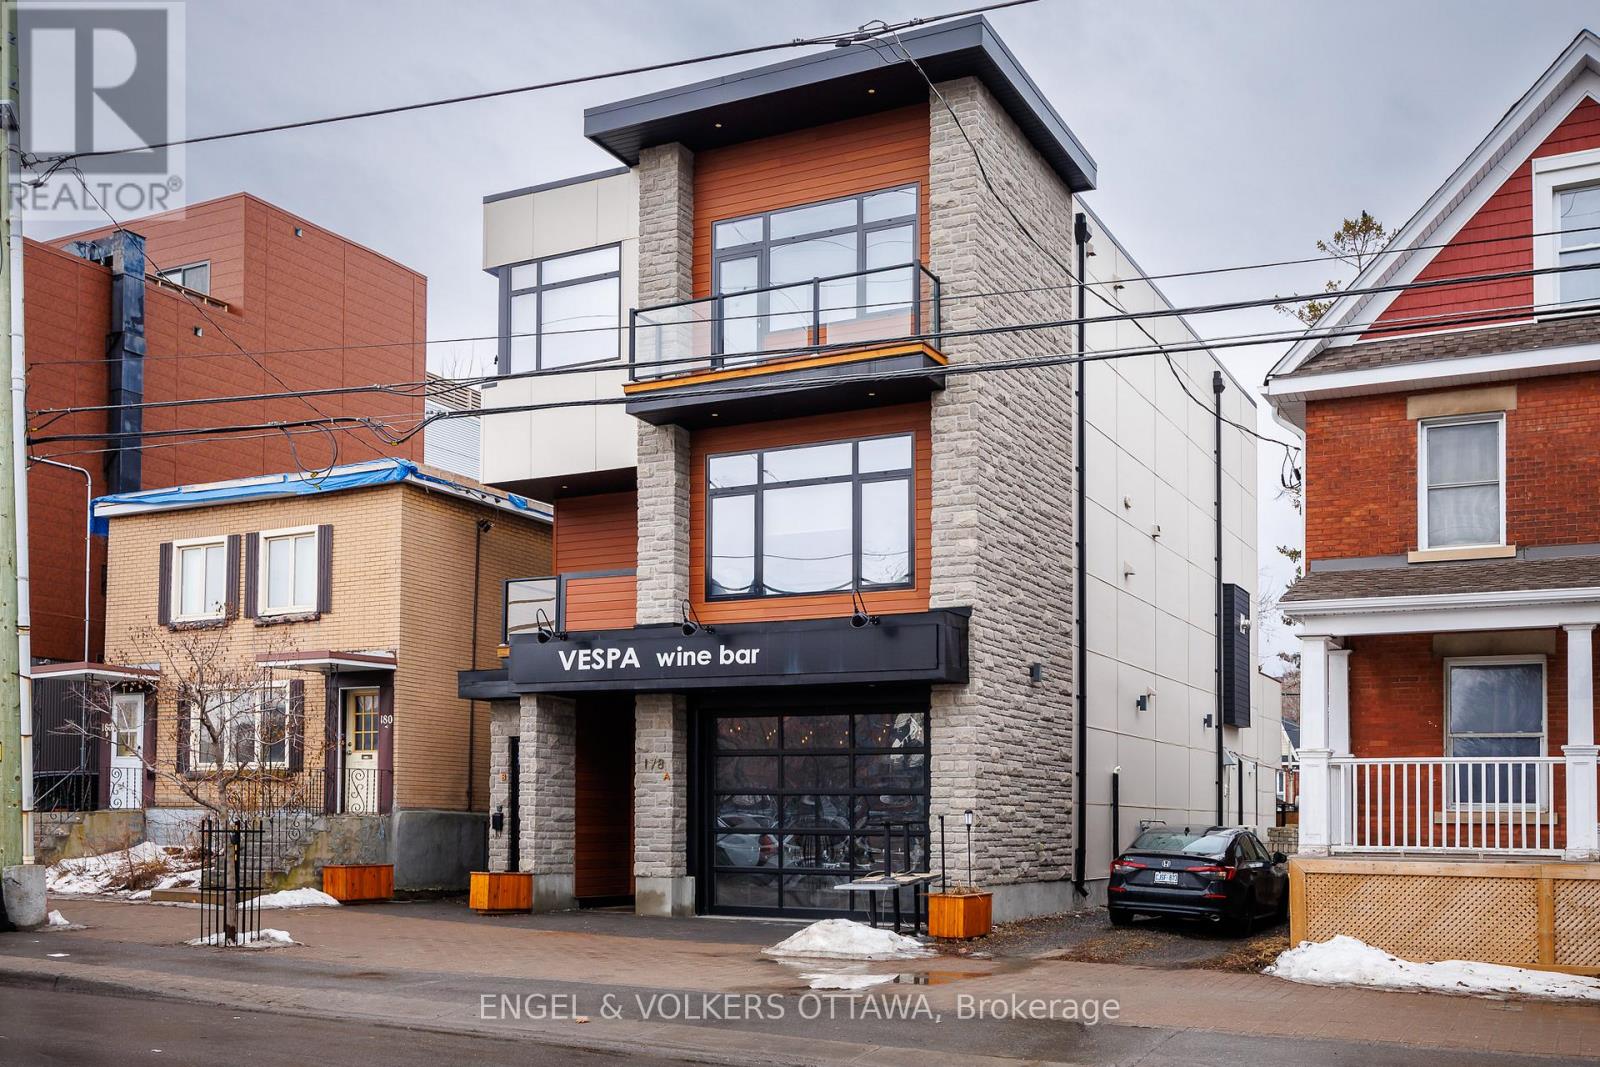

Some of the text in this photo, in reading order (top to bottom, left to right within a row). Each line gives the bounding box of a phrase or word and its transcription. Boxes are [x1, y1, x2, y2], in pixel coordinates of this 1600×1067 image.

[558, 644, 760, 671] VESPA wine bar
[380, 714, 393, 724] 180
[644, 758, 665, 770] 178
